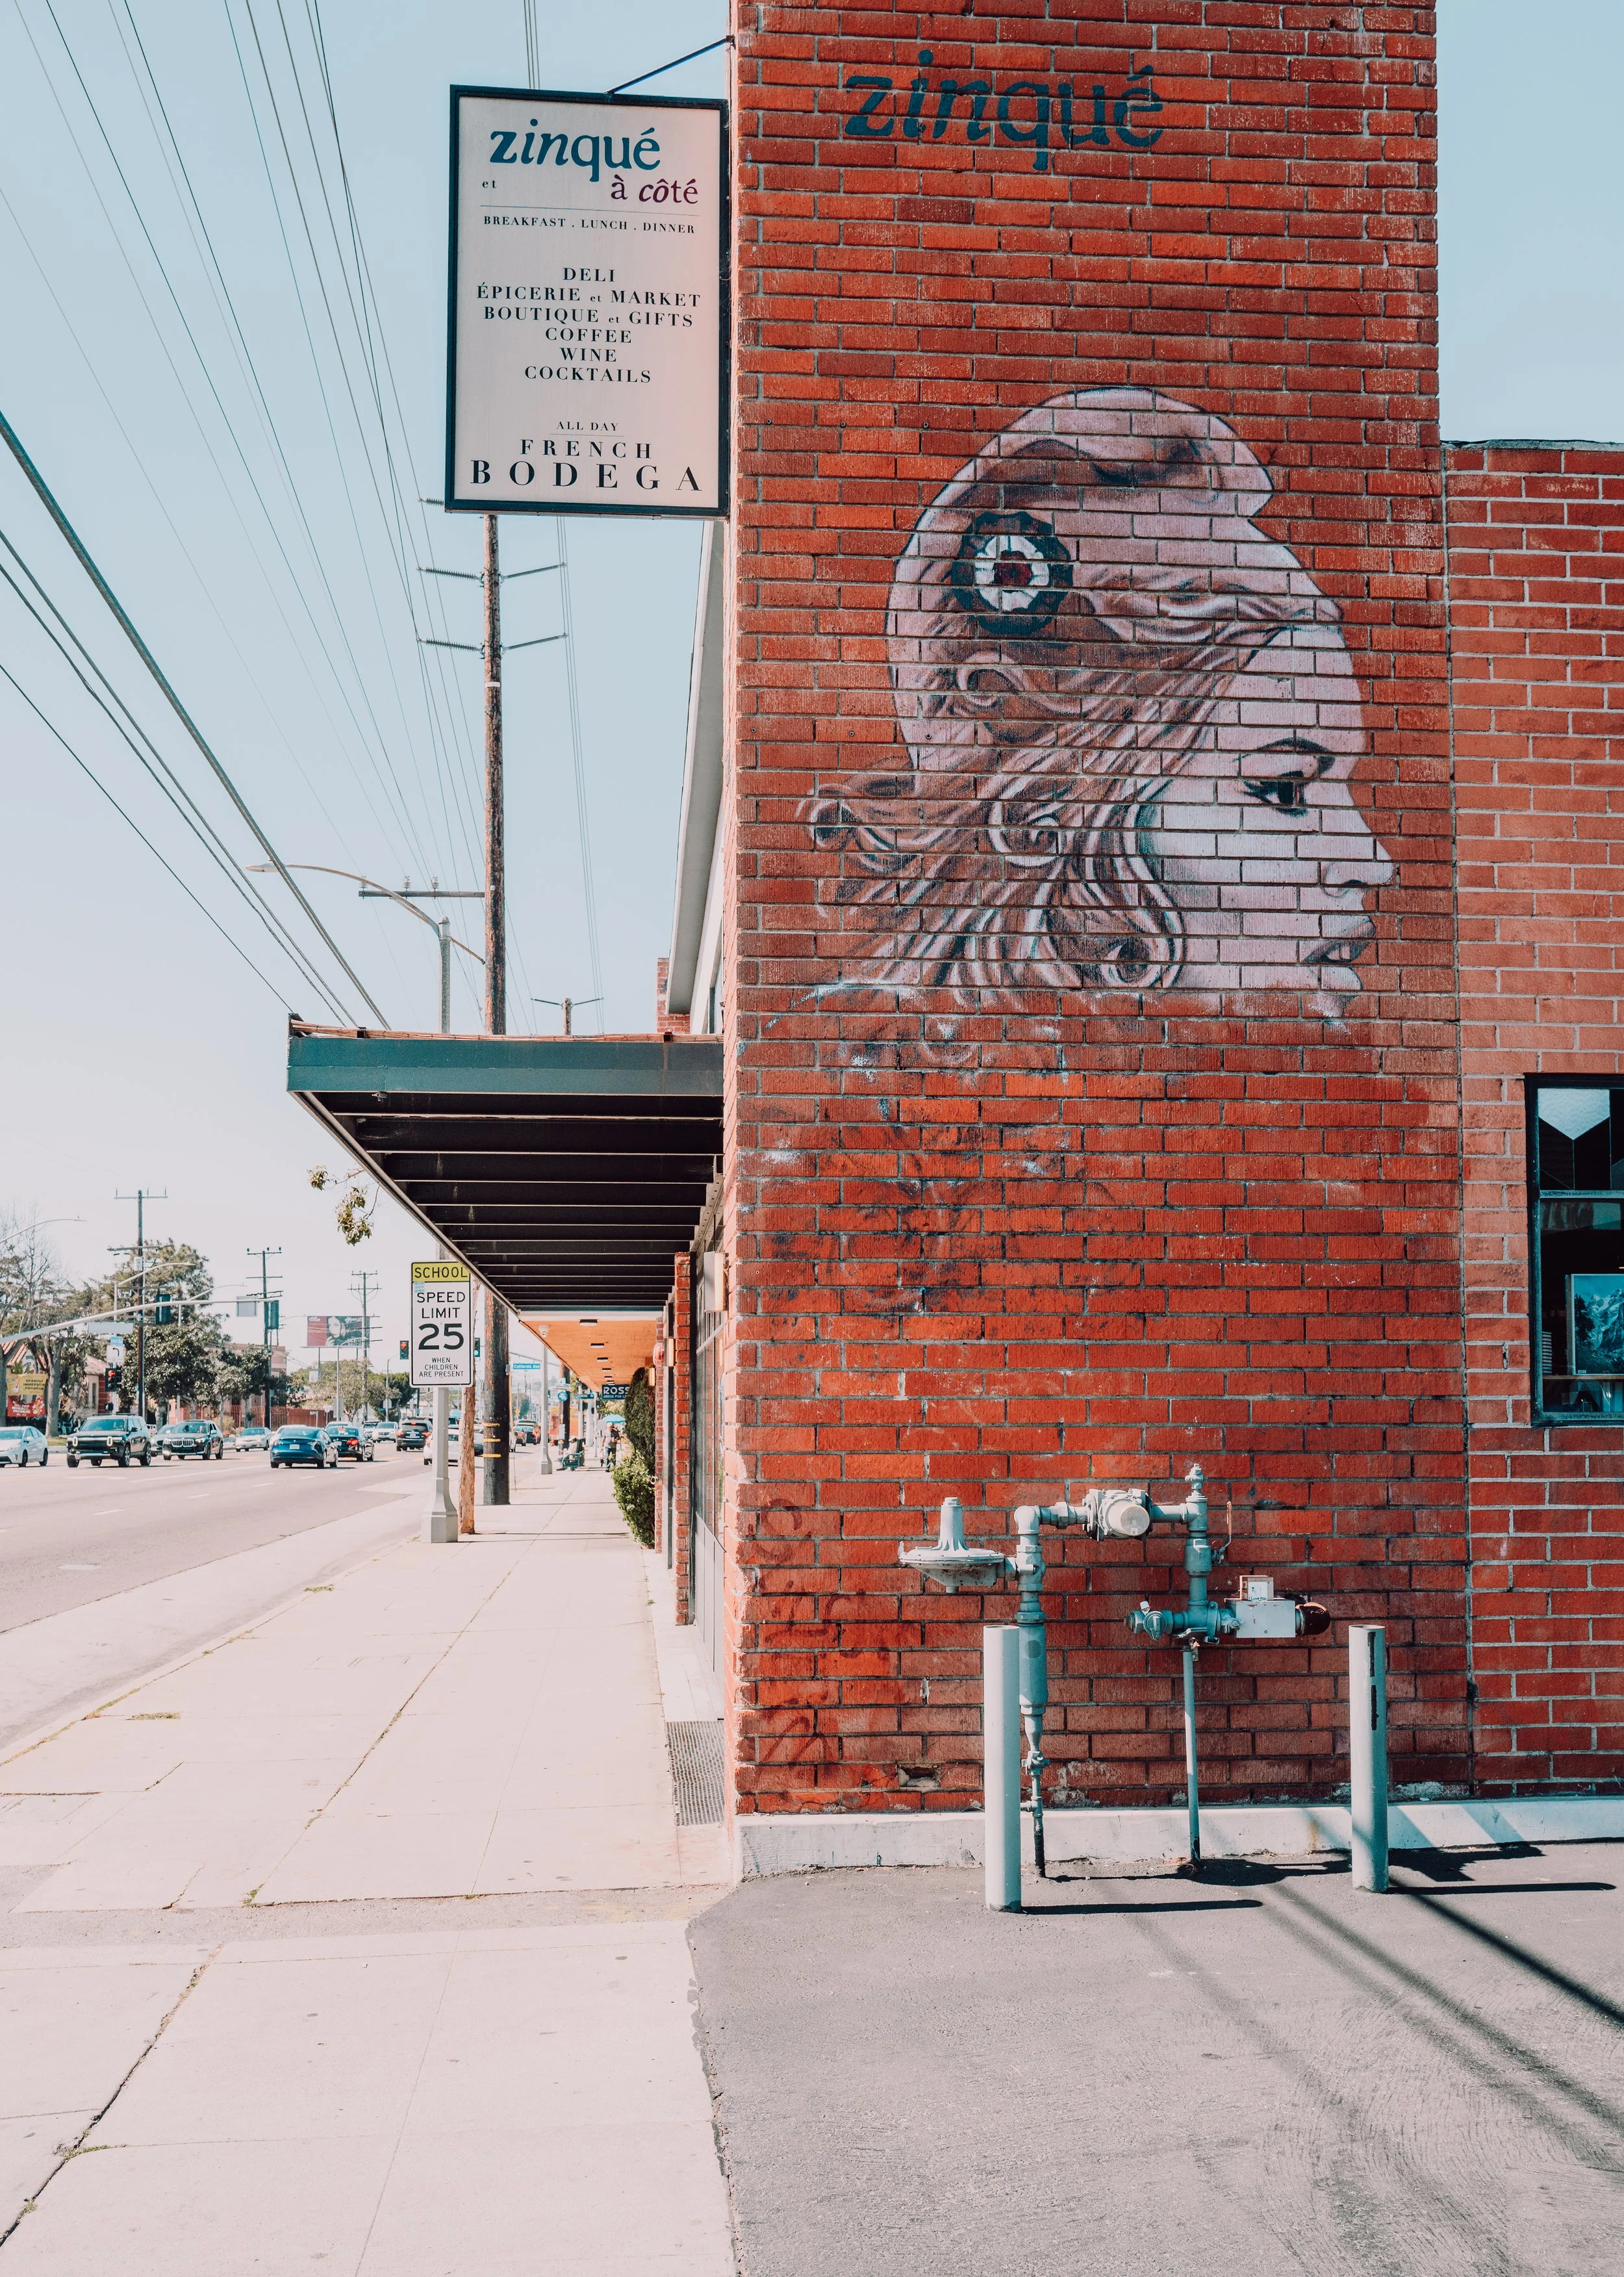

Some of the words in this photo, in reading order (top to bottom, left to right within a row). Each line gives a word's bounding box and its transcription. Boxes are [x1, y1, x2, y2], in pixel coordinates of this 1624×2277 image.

[844, 49, 1163, 171] zinqué
[489, 118, 661, 183] zinqué
[482, 180, 496, 188] et
[611, 174, 628, 200] à
[638, 178, 698, 205] côté
[483, 216, 566, 227] BREAKFAST
[581, 219, 628, 230] LUNCH
[642, 222, 695, 234] DINNER
[563, 267, 615, 283] DELI
[477, 282, 580, 301] ÉPICERIE
[610, 290, 701, 307] MARKET
[483, 306, 599, 325] BOUTIQUE
[628, 311, 693, 327] GIFTS
[545, 327, 632, 344] COFFEE
[559, 348, 617, 363] WINE
[524, 366, 652, 383] COCKTAILS
[557, 421, 583, 431] ALL
[590, 422, 618, 432] DAY
[520, 439, 652, 459] FRENCH
[470, 459, 702, 492] BODEGA
[414, 1266, 468, 1278] SCHOOL
[416, 1291, 466, 1303] SPEED
[422, 1307, 461, 1319] LIMIT
[418, 1323, 464, 1351] 25
[603, 1386, 629, 1395] ROSS
